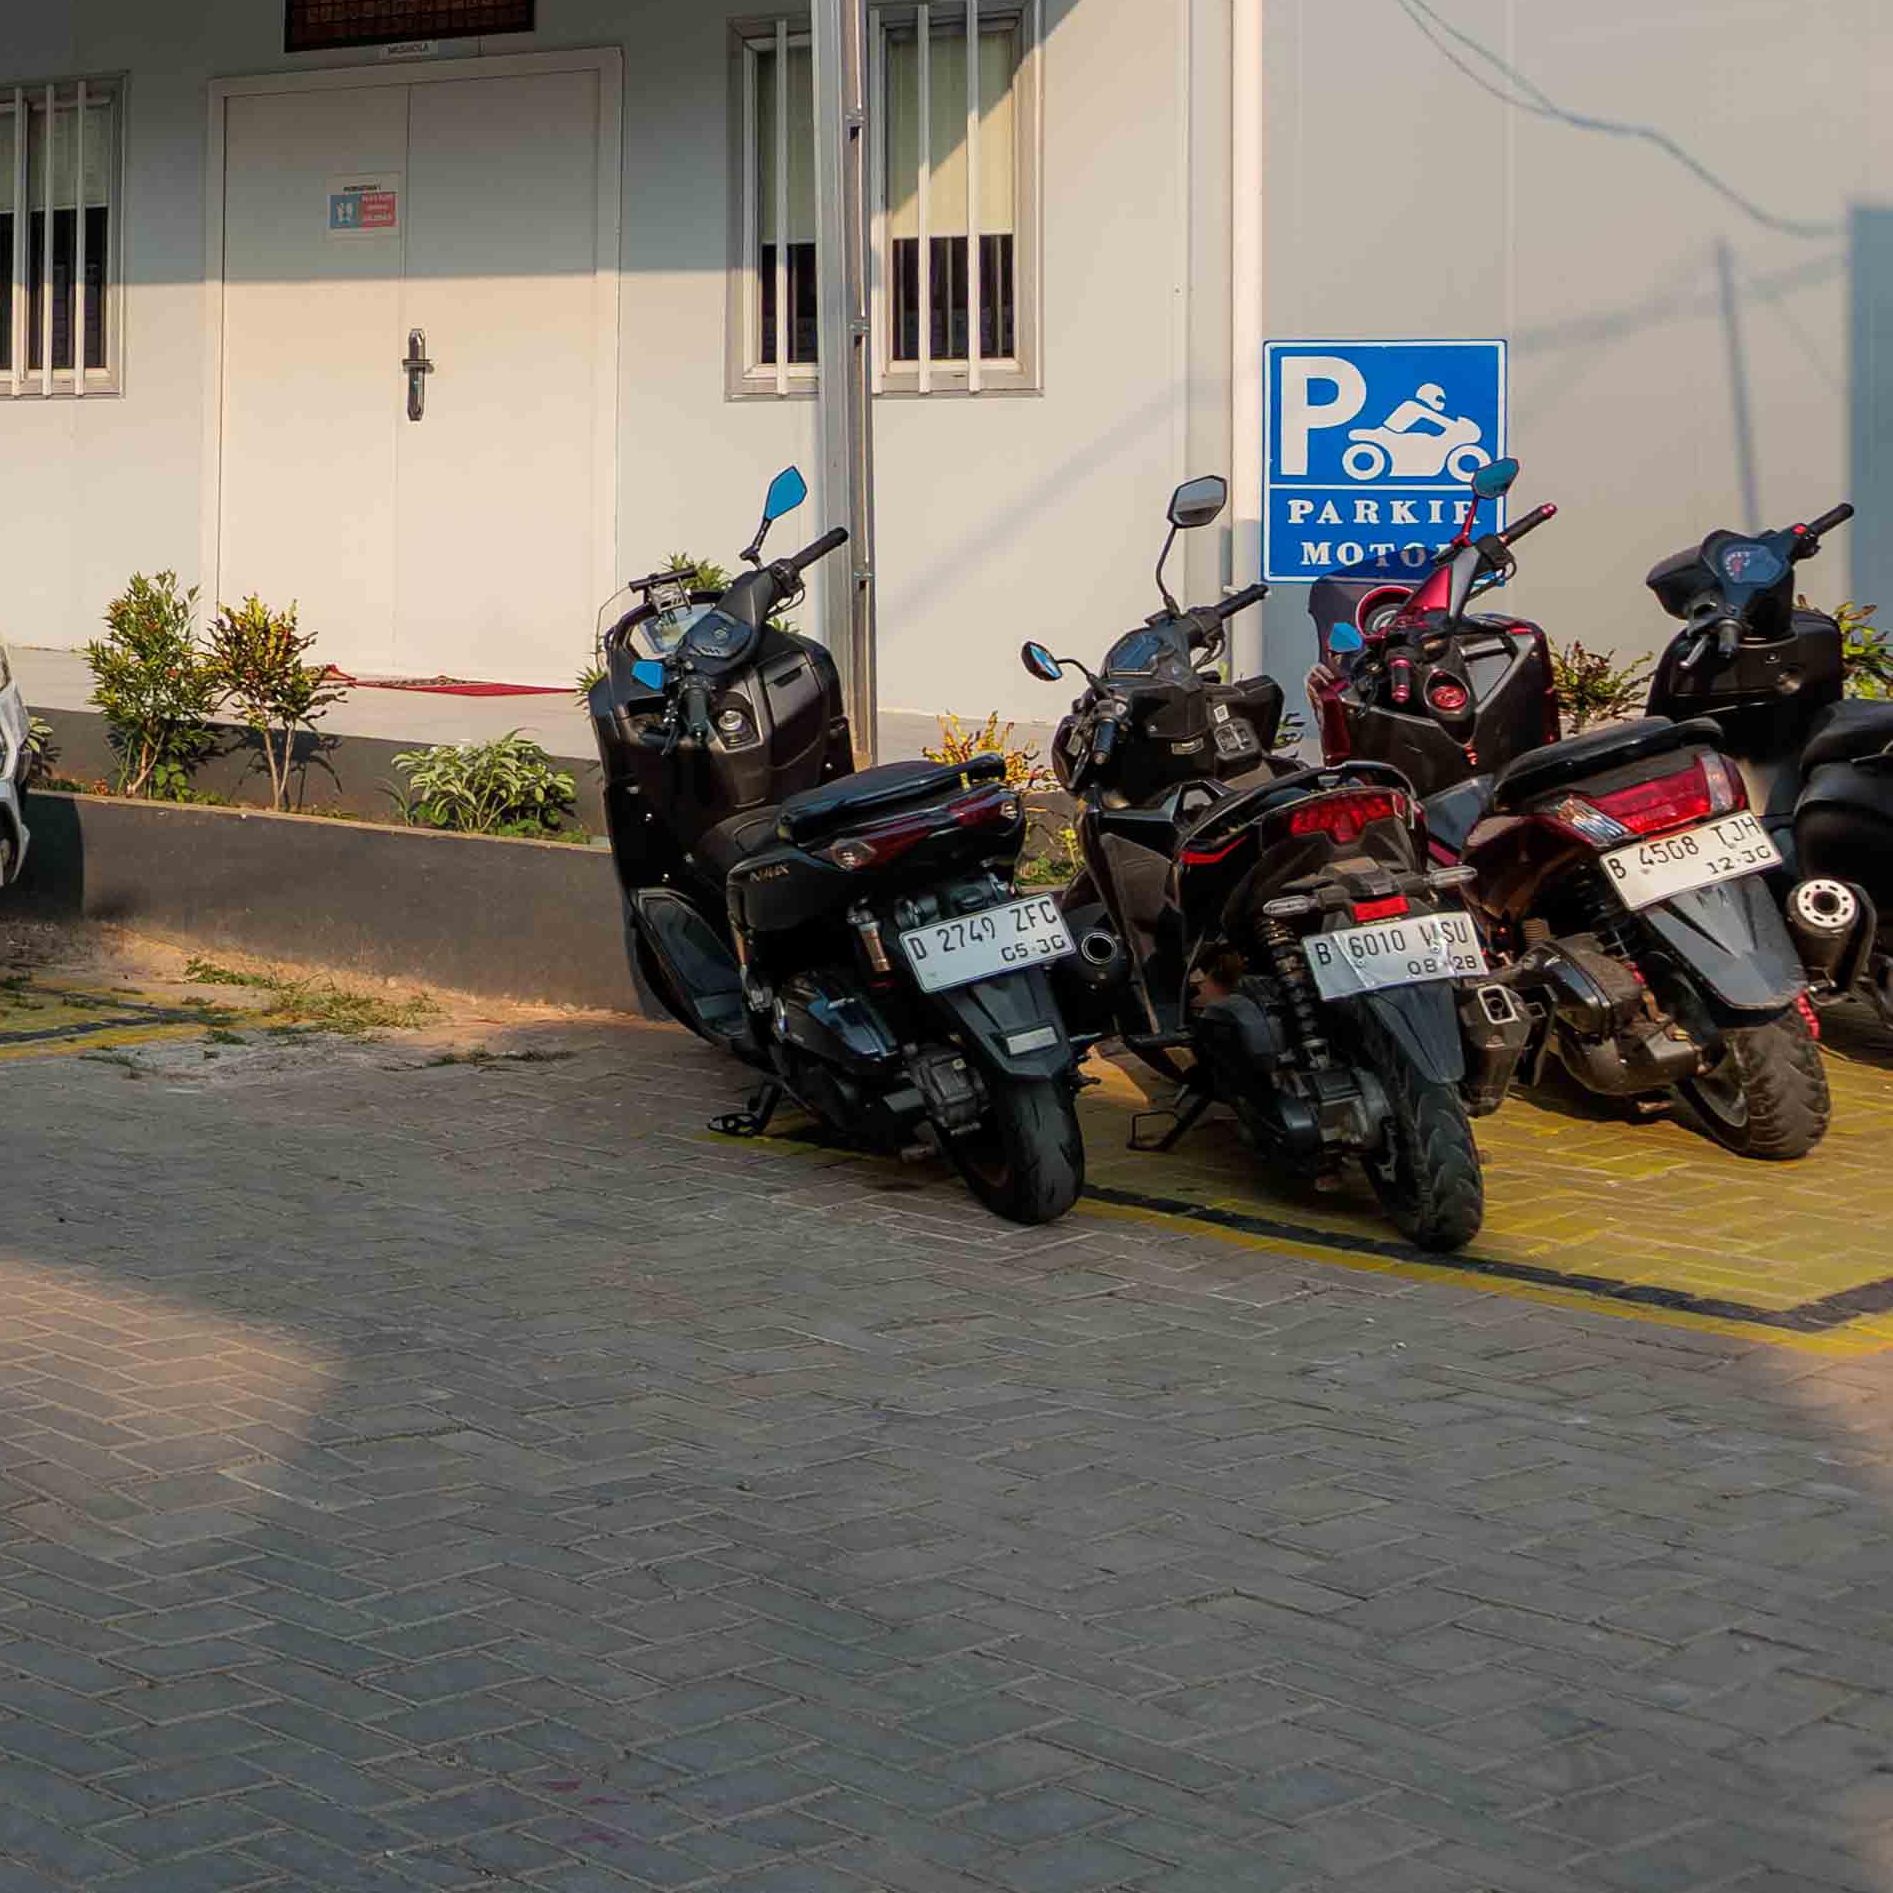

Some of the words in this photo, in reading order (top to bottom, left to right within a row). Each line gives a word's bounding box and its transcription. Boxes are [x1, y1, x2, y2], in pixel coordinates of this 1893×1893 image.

[1281, 356, 1366, 475] P
[1287, 499, 1480, 524] PARKIR
[1608, 858, 1626, 879] B
[1639, 835, 1699, 867] 4508
[1710, 816, 1761, 847] TJH
[908, 937, 927, 960] D
[936, 916, 996, 952] 2749
[1009, 900, 1057, 932] ZFC
[1316, 942, 1332, 965] B
[1348, 929, 1407, 958] 6010
